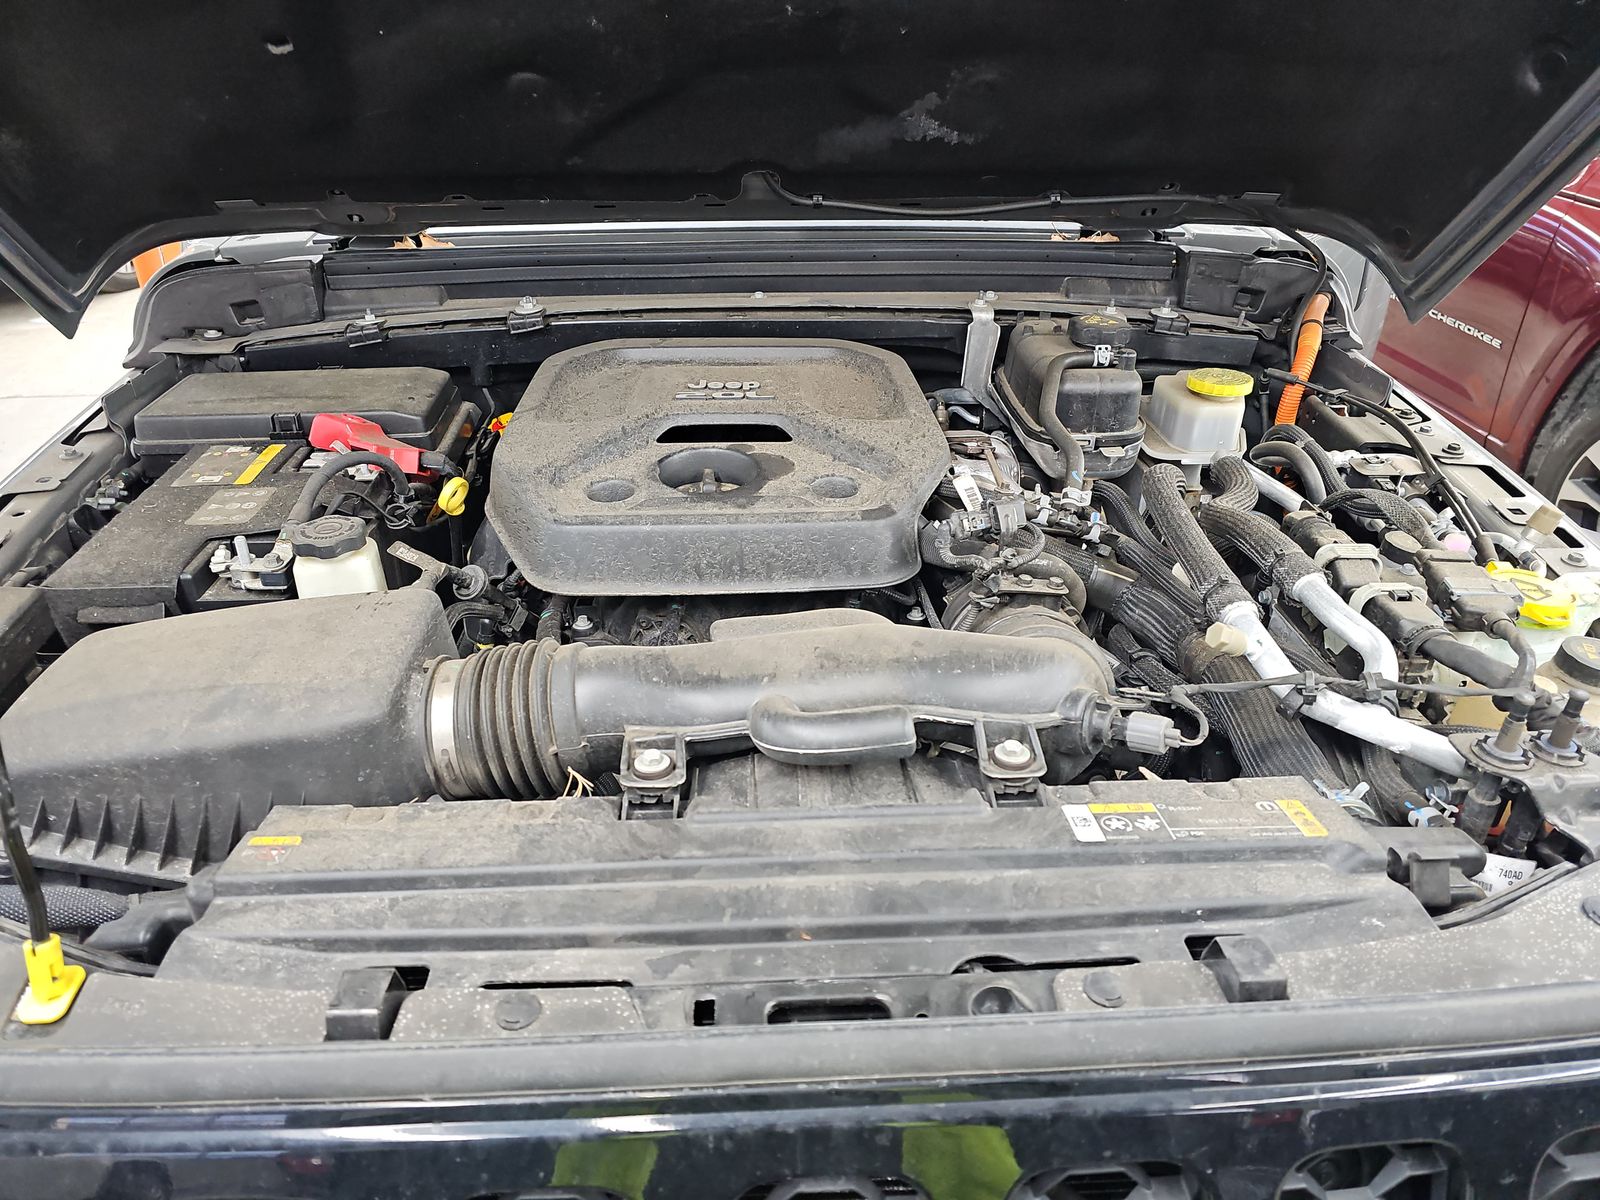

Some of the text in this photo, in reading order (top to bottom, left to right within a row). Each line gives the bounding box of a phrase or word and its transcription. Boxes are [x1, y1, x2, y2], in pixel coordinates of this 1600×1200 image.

[1428, 309, 1502, 349] CHEROKEE
[687, 379, 761, 391] Jeep
[1498, 867, 1524, 881] 740AD
